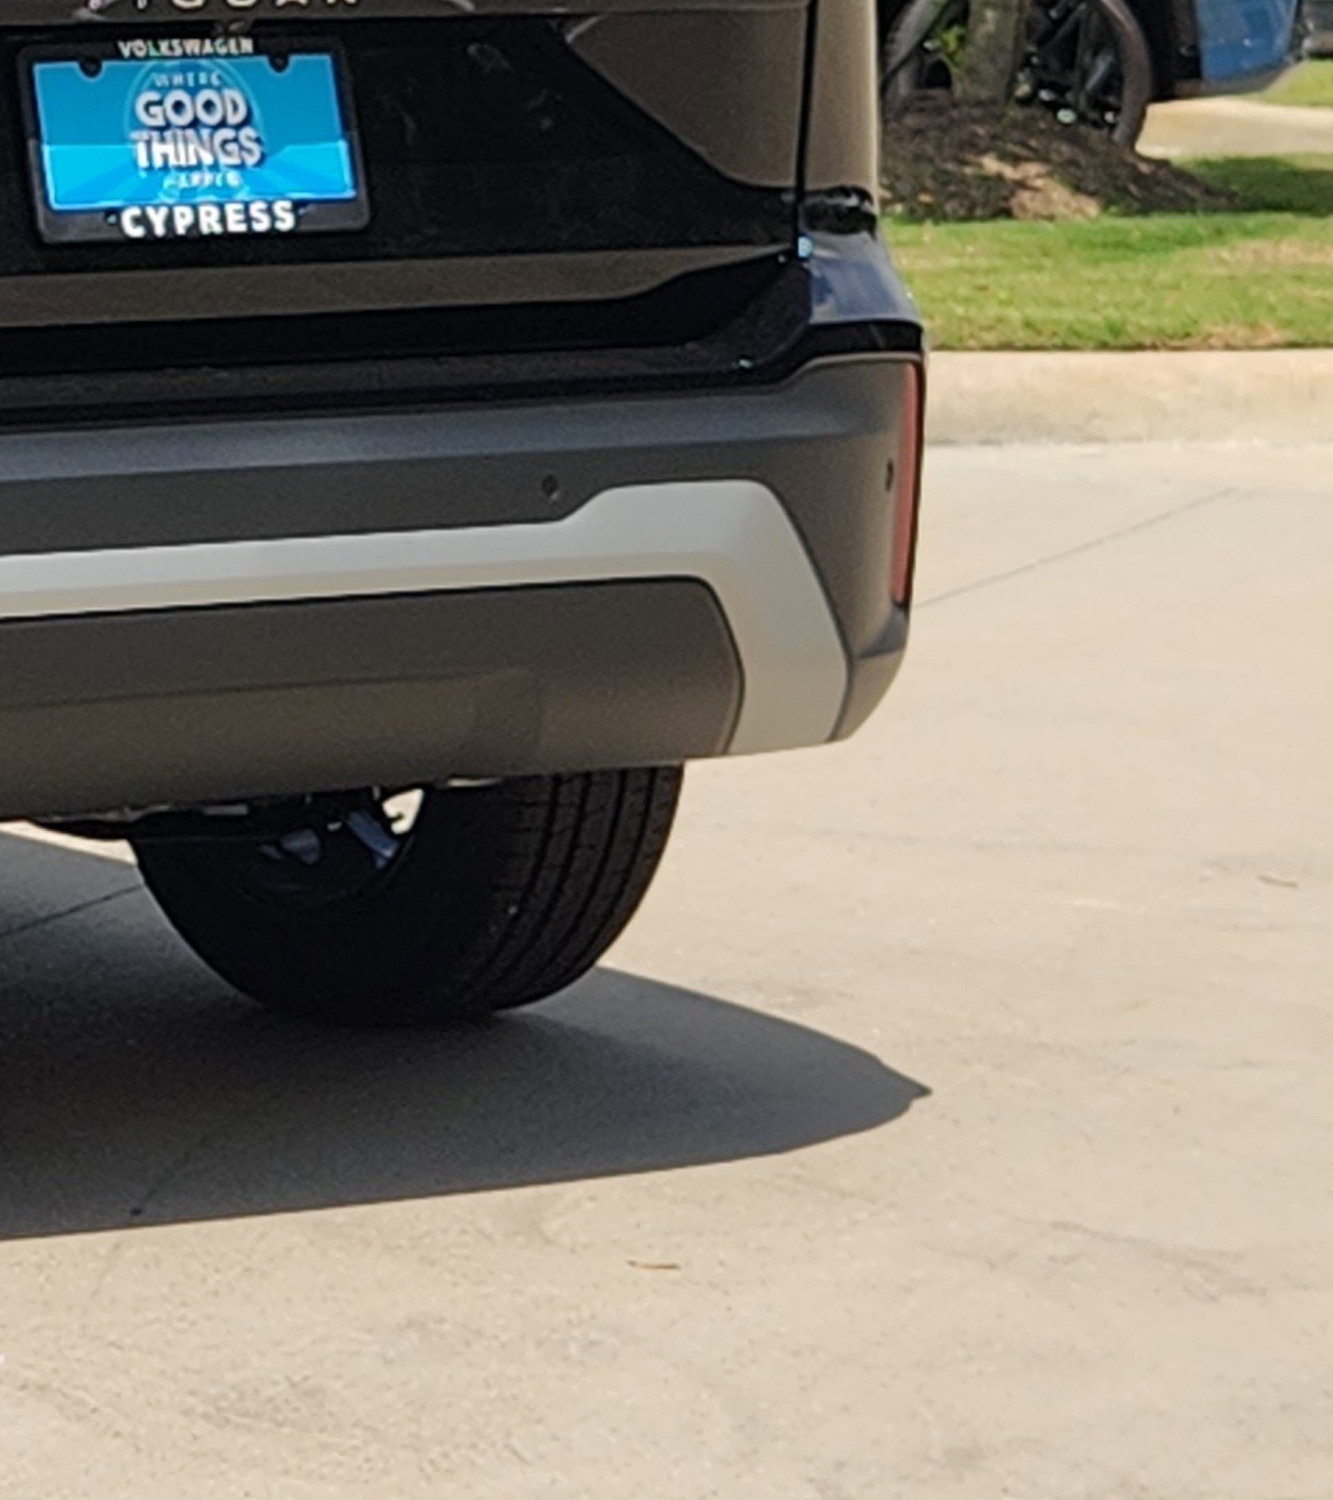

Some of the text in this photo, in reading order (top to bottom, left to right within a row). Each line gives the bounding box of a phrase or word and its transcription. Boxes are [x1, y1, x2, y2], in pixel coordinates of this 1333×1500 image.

[117, 36, 255, 58] VOLKSWAGEN
[135, 88, 248, 127] GOOD
[130, 126, 263, 169] THINGS
[120, 199, 296, 238] CYPRESS
